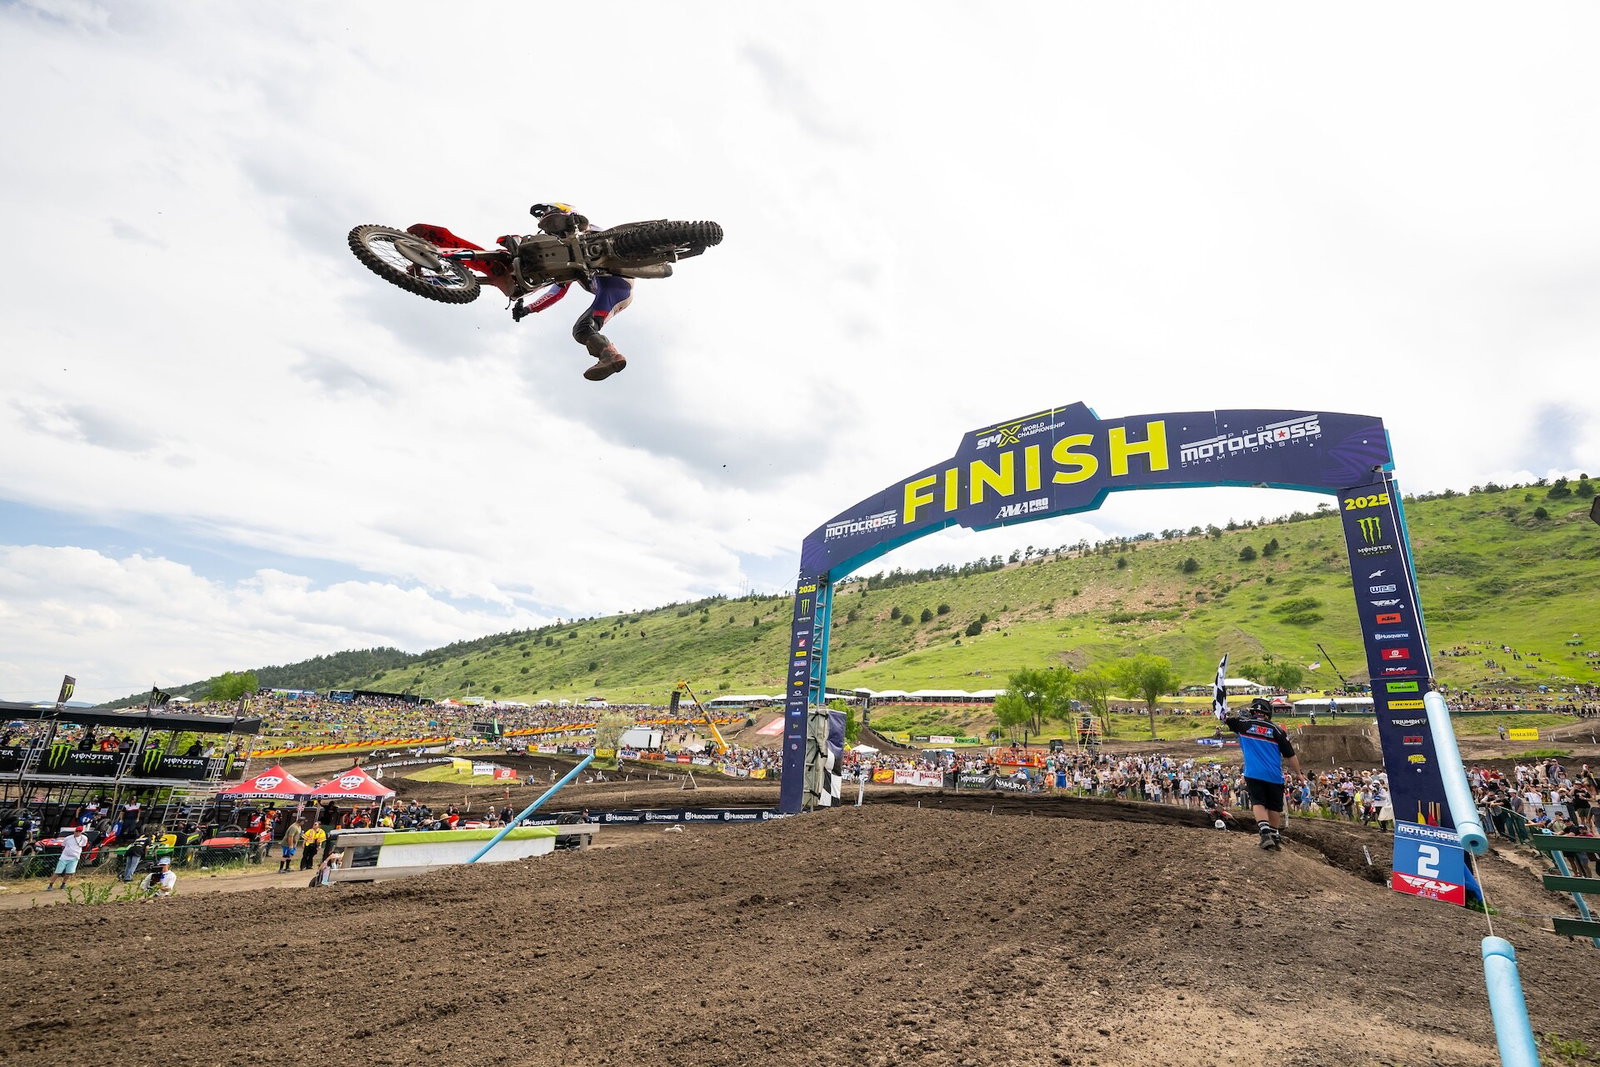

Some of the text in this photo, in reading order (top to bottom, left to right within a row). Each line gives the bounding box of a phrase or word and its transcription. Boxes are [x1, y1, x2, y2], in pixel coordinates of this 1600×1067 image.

[976, 421, 1066, 450] SMX CHAMPIONSHIP
[1022, 422, 1045, 432] WORLD
[1227, 426, 1264, 439] PRO
[1180, 420, 1321, 462] MOTOCROSS
[1181, 433, 1322, 468] CHAMPIONSHIP
[902, 420, 1169, 525] FINISH
[994, 497, 1049, 520] AMA PRO
[1343, 493, 1389, 511] 2025
[824, 523, 897, 543] CHAMPIONSHIP
[825, 513, 898, 538] MOTOCROSS
[1357, 545, 1393, 554] MONSTER
[798, 584, 817, 594] 2025
[1380, 632, 1409, 640] Husqvarna
[70, 752, 114, 761] MONSTER
[163, 757, 204, 766] MONSTER
[995, 779, 1027, 791] NAMURA
[1397, 825, 1461, 842] MOTOCROSS
[1417, 844, 1440, 879] 2
